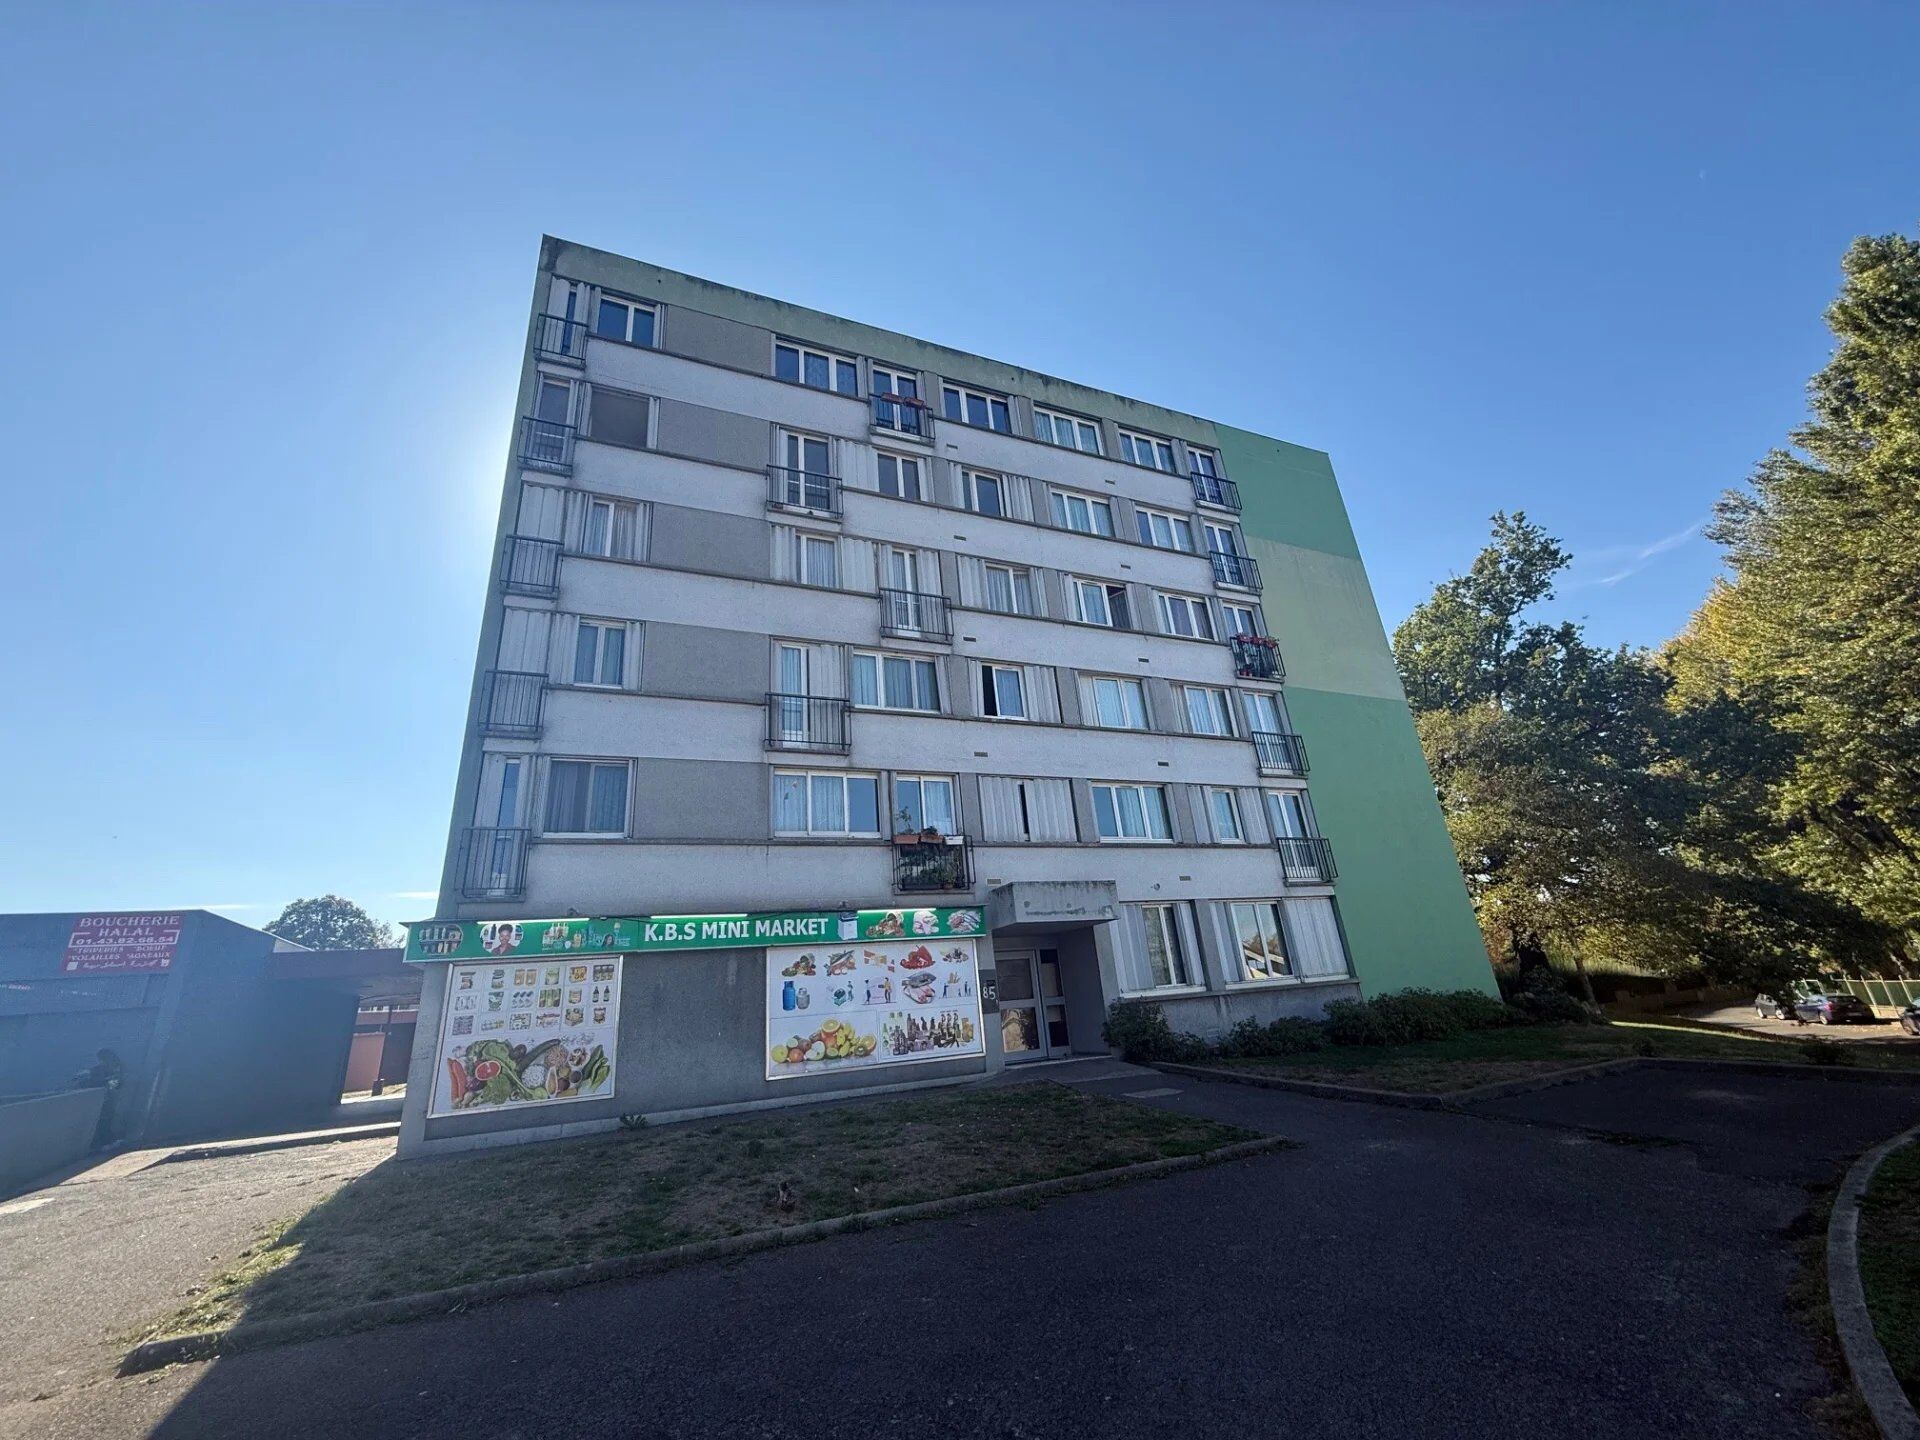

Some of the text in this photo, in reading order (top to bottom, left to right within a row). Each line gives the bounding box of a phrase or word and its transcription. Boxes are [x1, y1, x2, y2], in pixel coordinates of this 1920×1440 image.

[80, 915, 180, 928] BOUCHERIE
[99, 927, 153, 936] HALAL
[644, 918, 828, 941] K.B.S MINI MARKET
[983, 986, 996, 1000] 85
